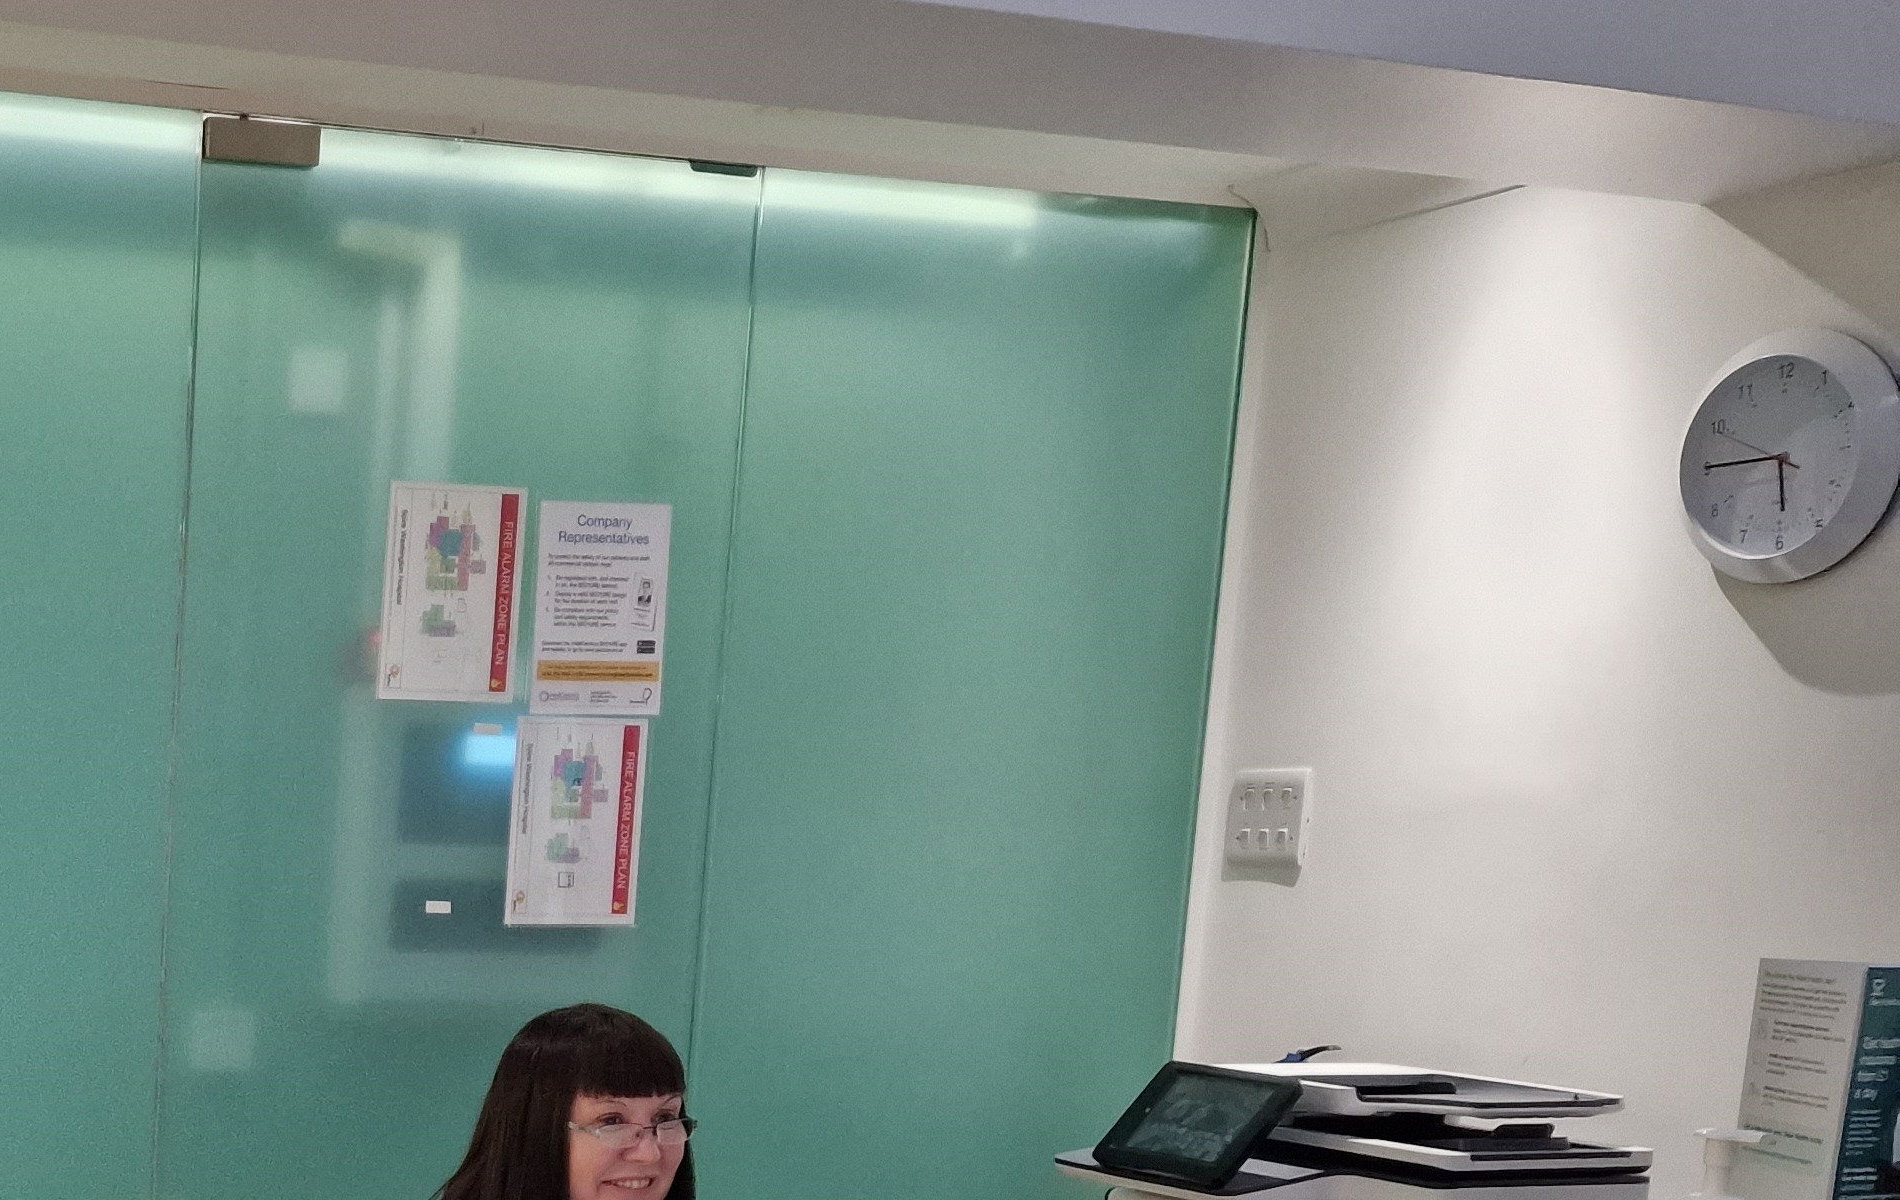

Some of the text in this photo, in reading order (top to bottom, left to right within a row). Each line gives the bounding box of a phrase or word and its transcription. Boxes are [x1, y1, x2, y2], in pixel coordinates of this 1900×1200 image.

[1778, 362, 1795, 379] 12
[1738, 384, 1754, 402] 11
[1711, 418, 1726, 435] 10
[577, 513, 633, 531] Company
[558, 530, 650, 545] Representatives
[495, 521, 514, 665] FIRE ALARM ZONE PLAN
[616, 752, 635, 889] FIRE ALARM ZONE PLAN
